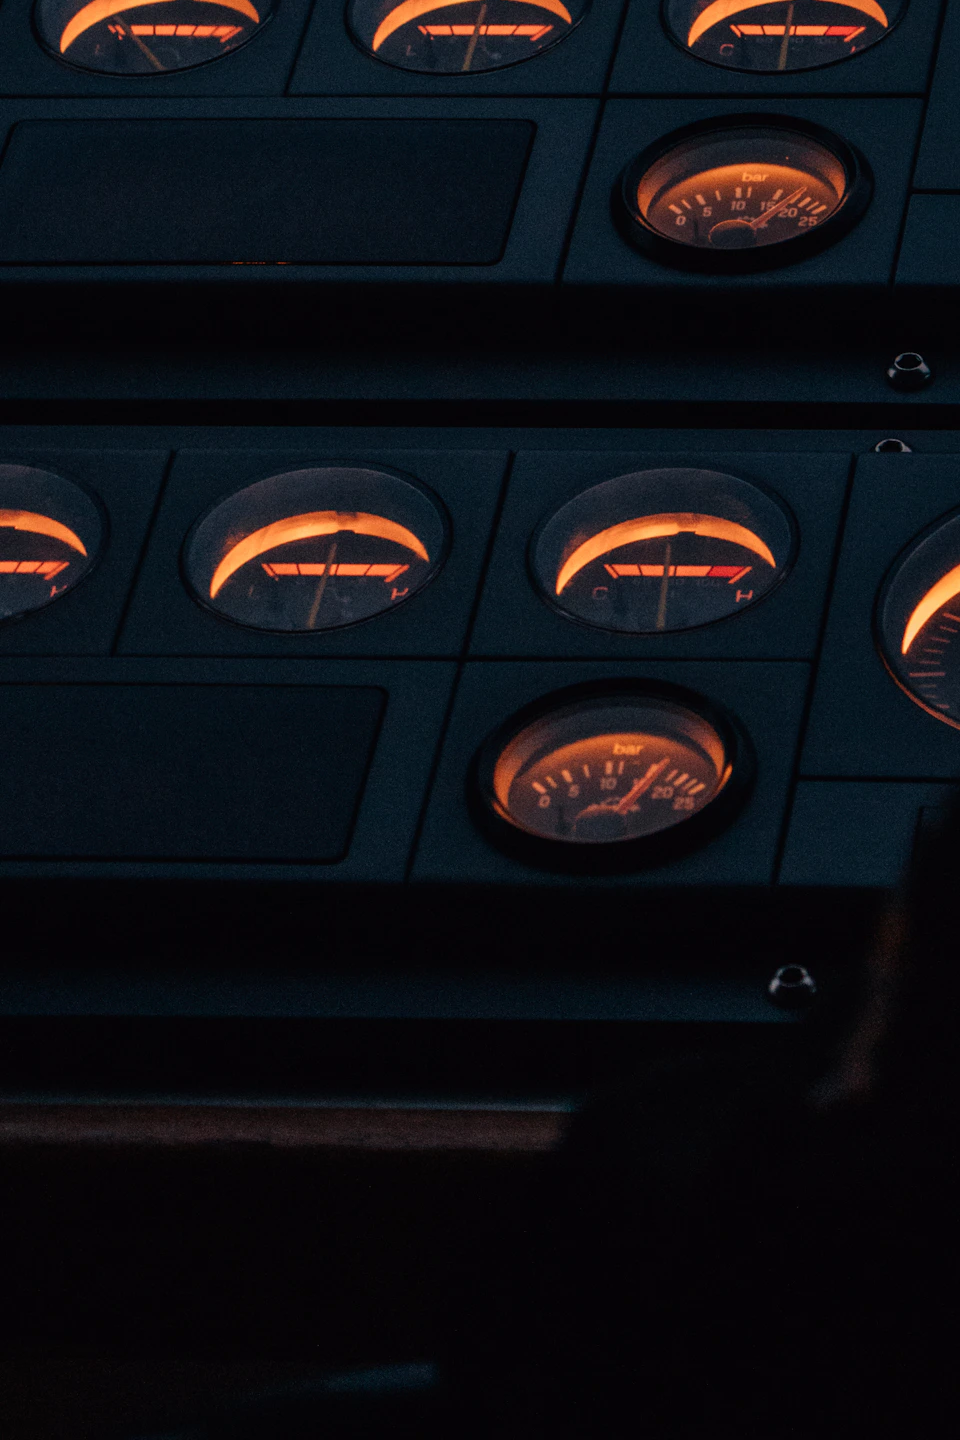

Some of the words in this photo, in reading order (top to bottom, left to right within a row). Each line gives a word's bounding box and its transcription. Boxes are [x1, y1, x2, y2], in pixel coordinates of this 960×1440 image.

[741, 172, 769, 182] bar
[730, 200, 747, 211] 10
[702, 206, 713, 218] 5
[778, 207, 799, 218] 20
[675, 215, 687, 227] 0
[798, 216, 818, 228] 25
[390, 577, 409, 592] H
[735, 589, 754, 604] H
[612, 743, 644, 756] bar
[652, 786, 675, 800] 20
[538, 794, 551, 809] 0
